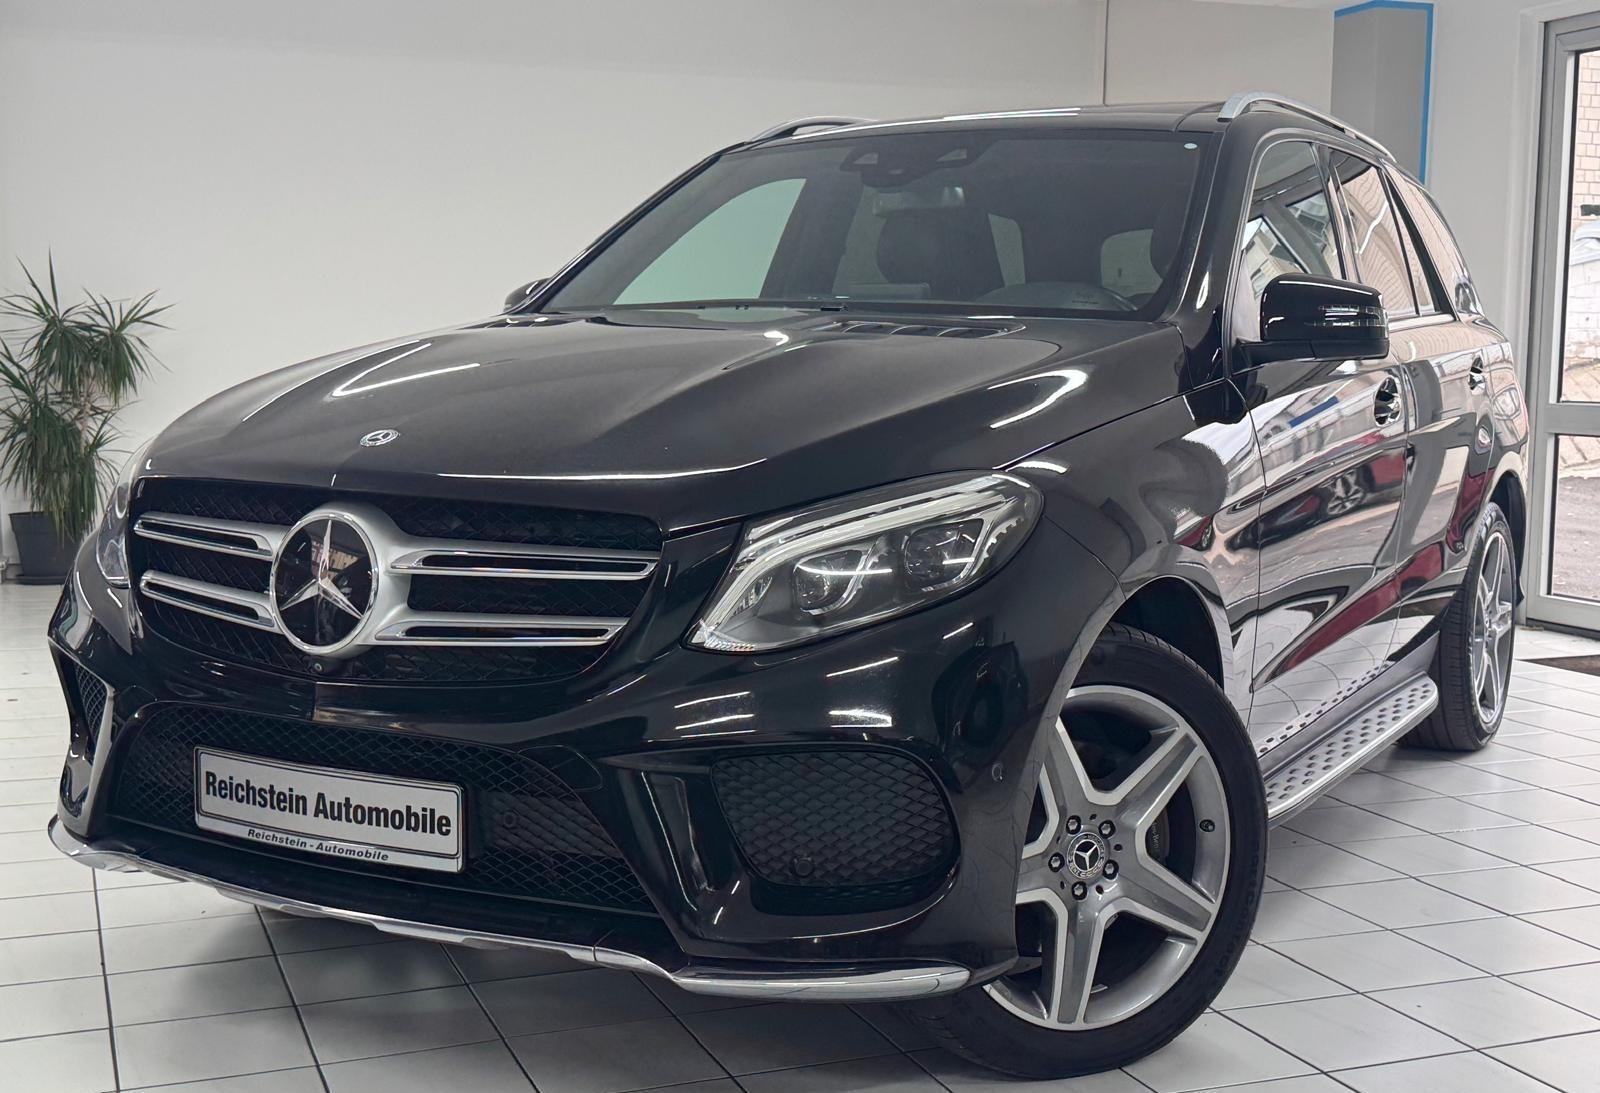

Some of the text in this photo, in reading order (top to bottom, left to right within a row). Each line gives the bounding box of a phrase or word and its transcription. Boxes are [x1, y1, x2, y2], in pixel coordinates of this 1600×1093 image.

[205, 771, 452, 836] Reichstein Automobile
[247, 828, 307, 848] Reichstein
[315, 842, 389, 861] Automobile
